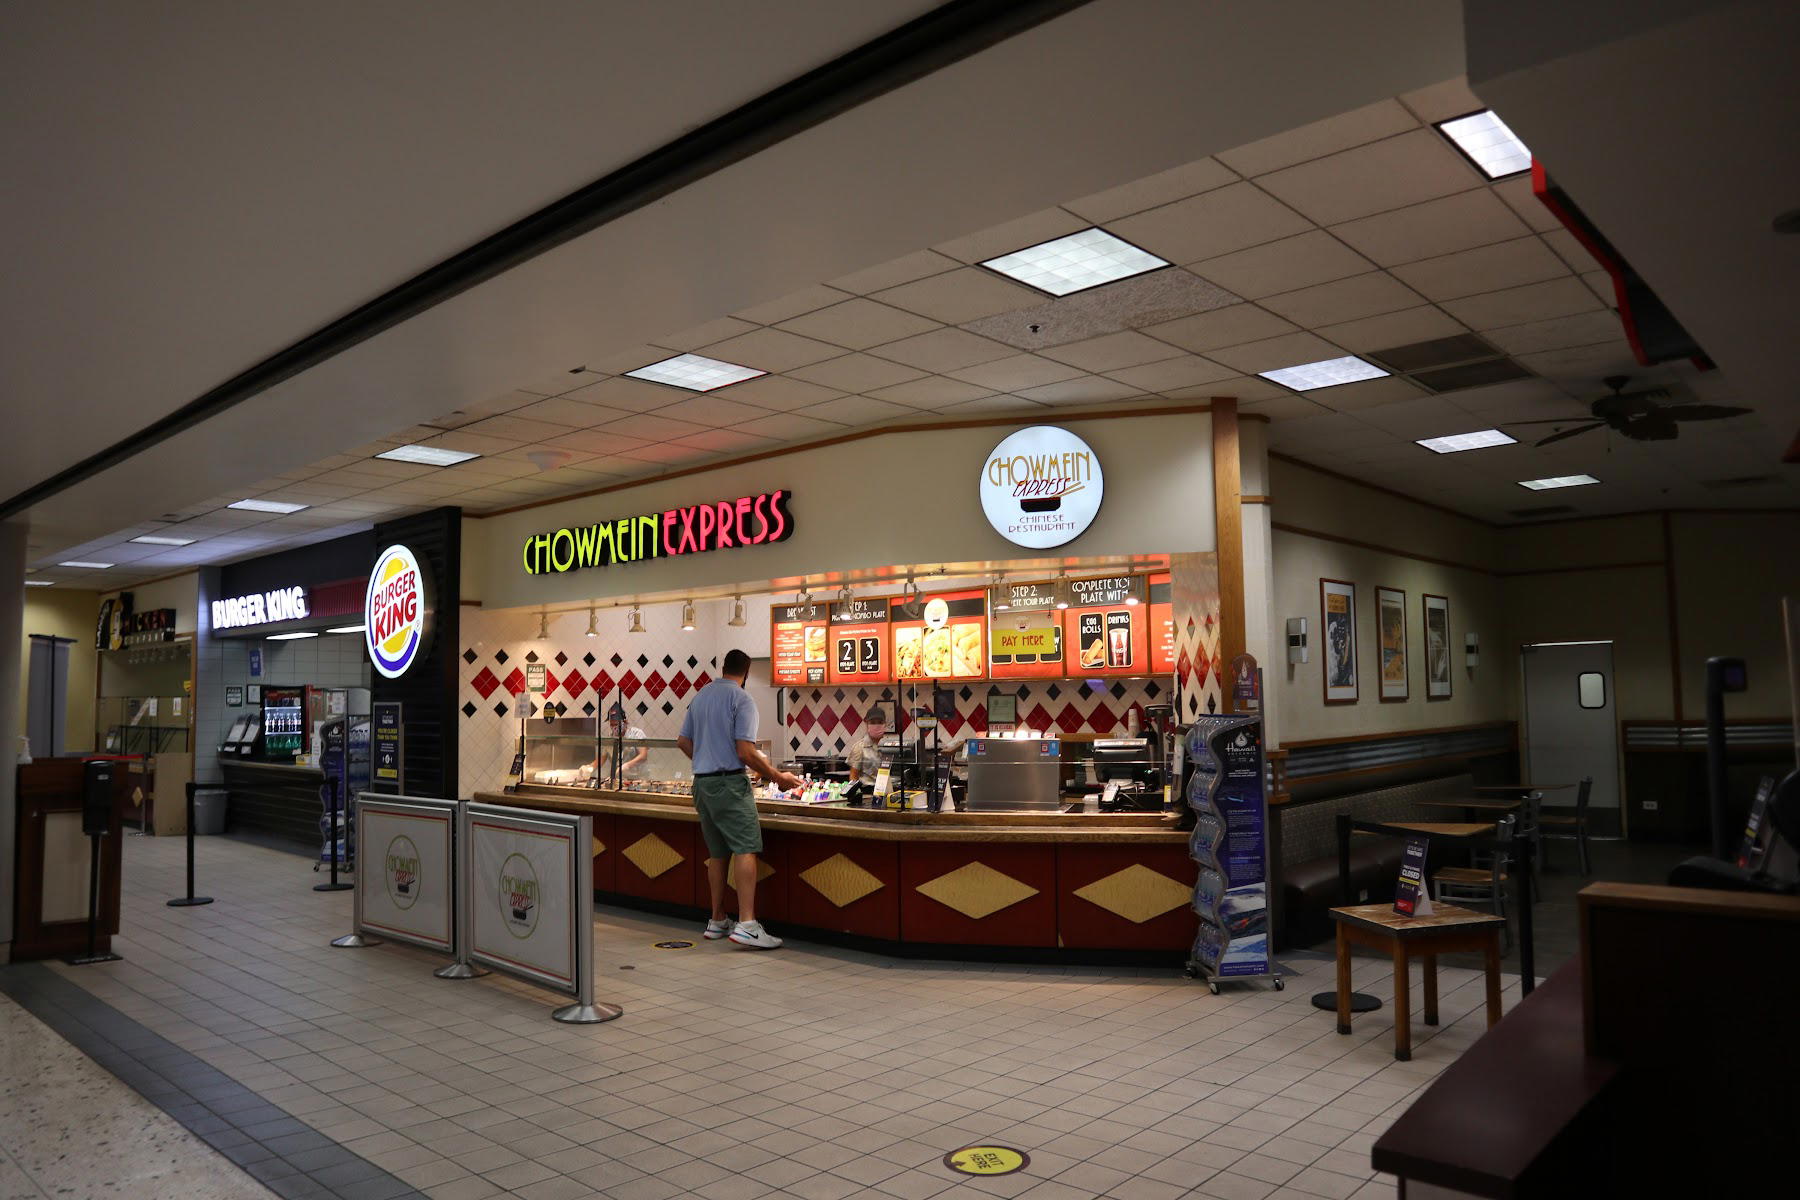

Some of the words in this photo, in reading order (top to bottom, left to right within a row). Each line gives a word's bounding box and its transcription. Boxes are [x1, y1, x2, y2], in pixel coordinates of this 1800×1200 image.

[988, 451, 1091, 486] CHOWMEIN
[1012, 478, 1071, 497] EXPRESS
[1019, 514, 1064, 523] CHINESE
[523, 513, 659, 575] CHOWMEIN
[662, 489, 790, 555] EXPRESS
[1008, 522, 1076, 533] RESTAURANT
[1011, 586, 1029, 598] STEP
[1030, 585, 1038, 597] 2:
[1071, 578, 1112, 592] COMPLETE
[374, 570, 415, 616] BURGER
[1080, 591, 1104, 604] PLATE
[1023, 598, 1038, 606] YOUR
[1038, 596, 1054, 605] PLATE
[212, 594, 267, 630] BURGER
[265, 586, 305, 622] KING
[872, 610, 886, 619] PLATE
[375, 591, 416, 647] KING
[1107, 615, 1130, 625] DRINKS
[1082, 625, 1102, 634] ROLLS
[1001, 635, 1018, 647] PAY
[1022, 634, 1045, 646] HERE
[842, 641, 852, 661] 2
[865, 640, 874, 660] 3
[1401, 869, 1420, 880] CLOSED
